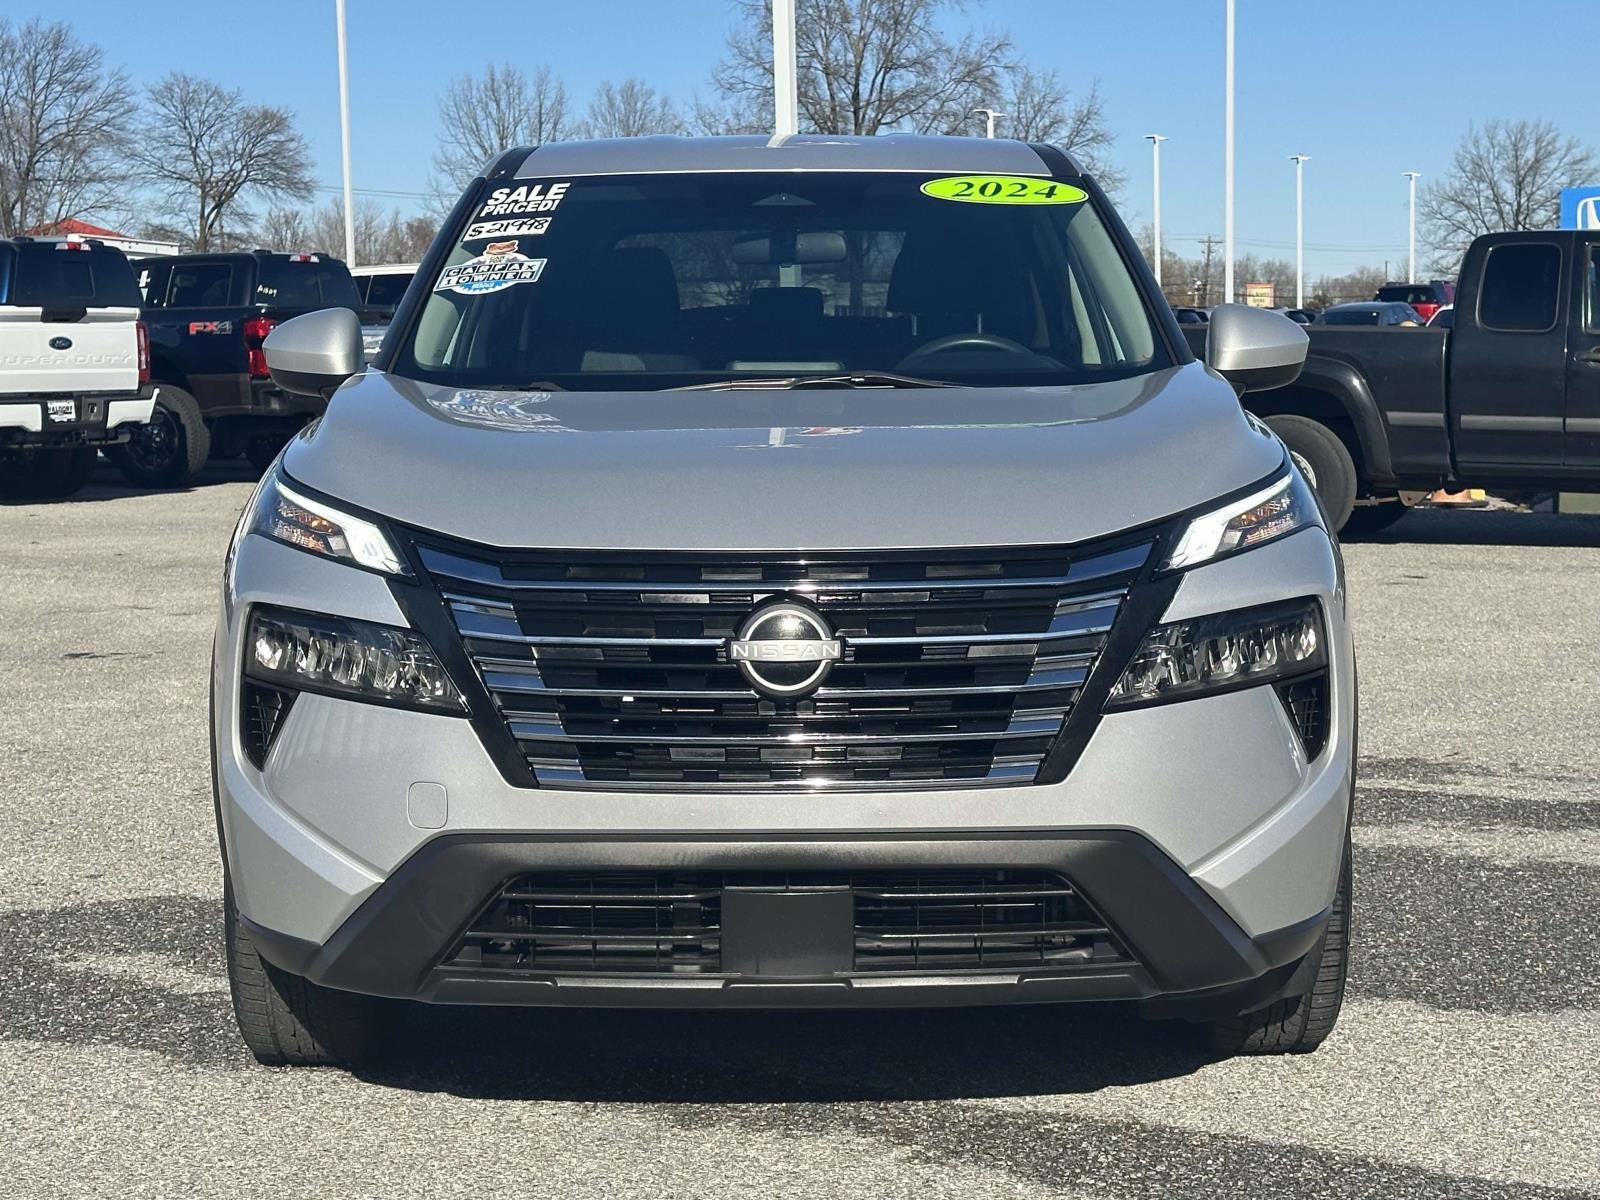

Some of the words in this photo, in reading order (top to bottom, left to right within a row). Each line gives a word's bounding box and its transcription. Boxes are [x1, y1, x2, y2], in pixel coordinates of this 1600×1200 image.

[487, 183, 571, 205] SALE
[952, 181, 1058, 199] 2024
[480, 200, 560, 217] PRICED!
[448, 263, 536, 277] CARFAX
[459, 271, 534, 283] OWNER
[189, 321, 233, 335] FX4
[75, 351, 132, 365] DUTY
[732, 643, 839, 658] NISSAN
